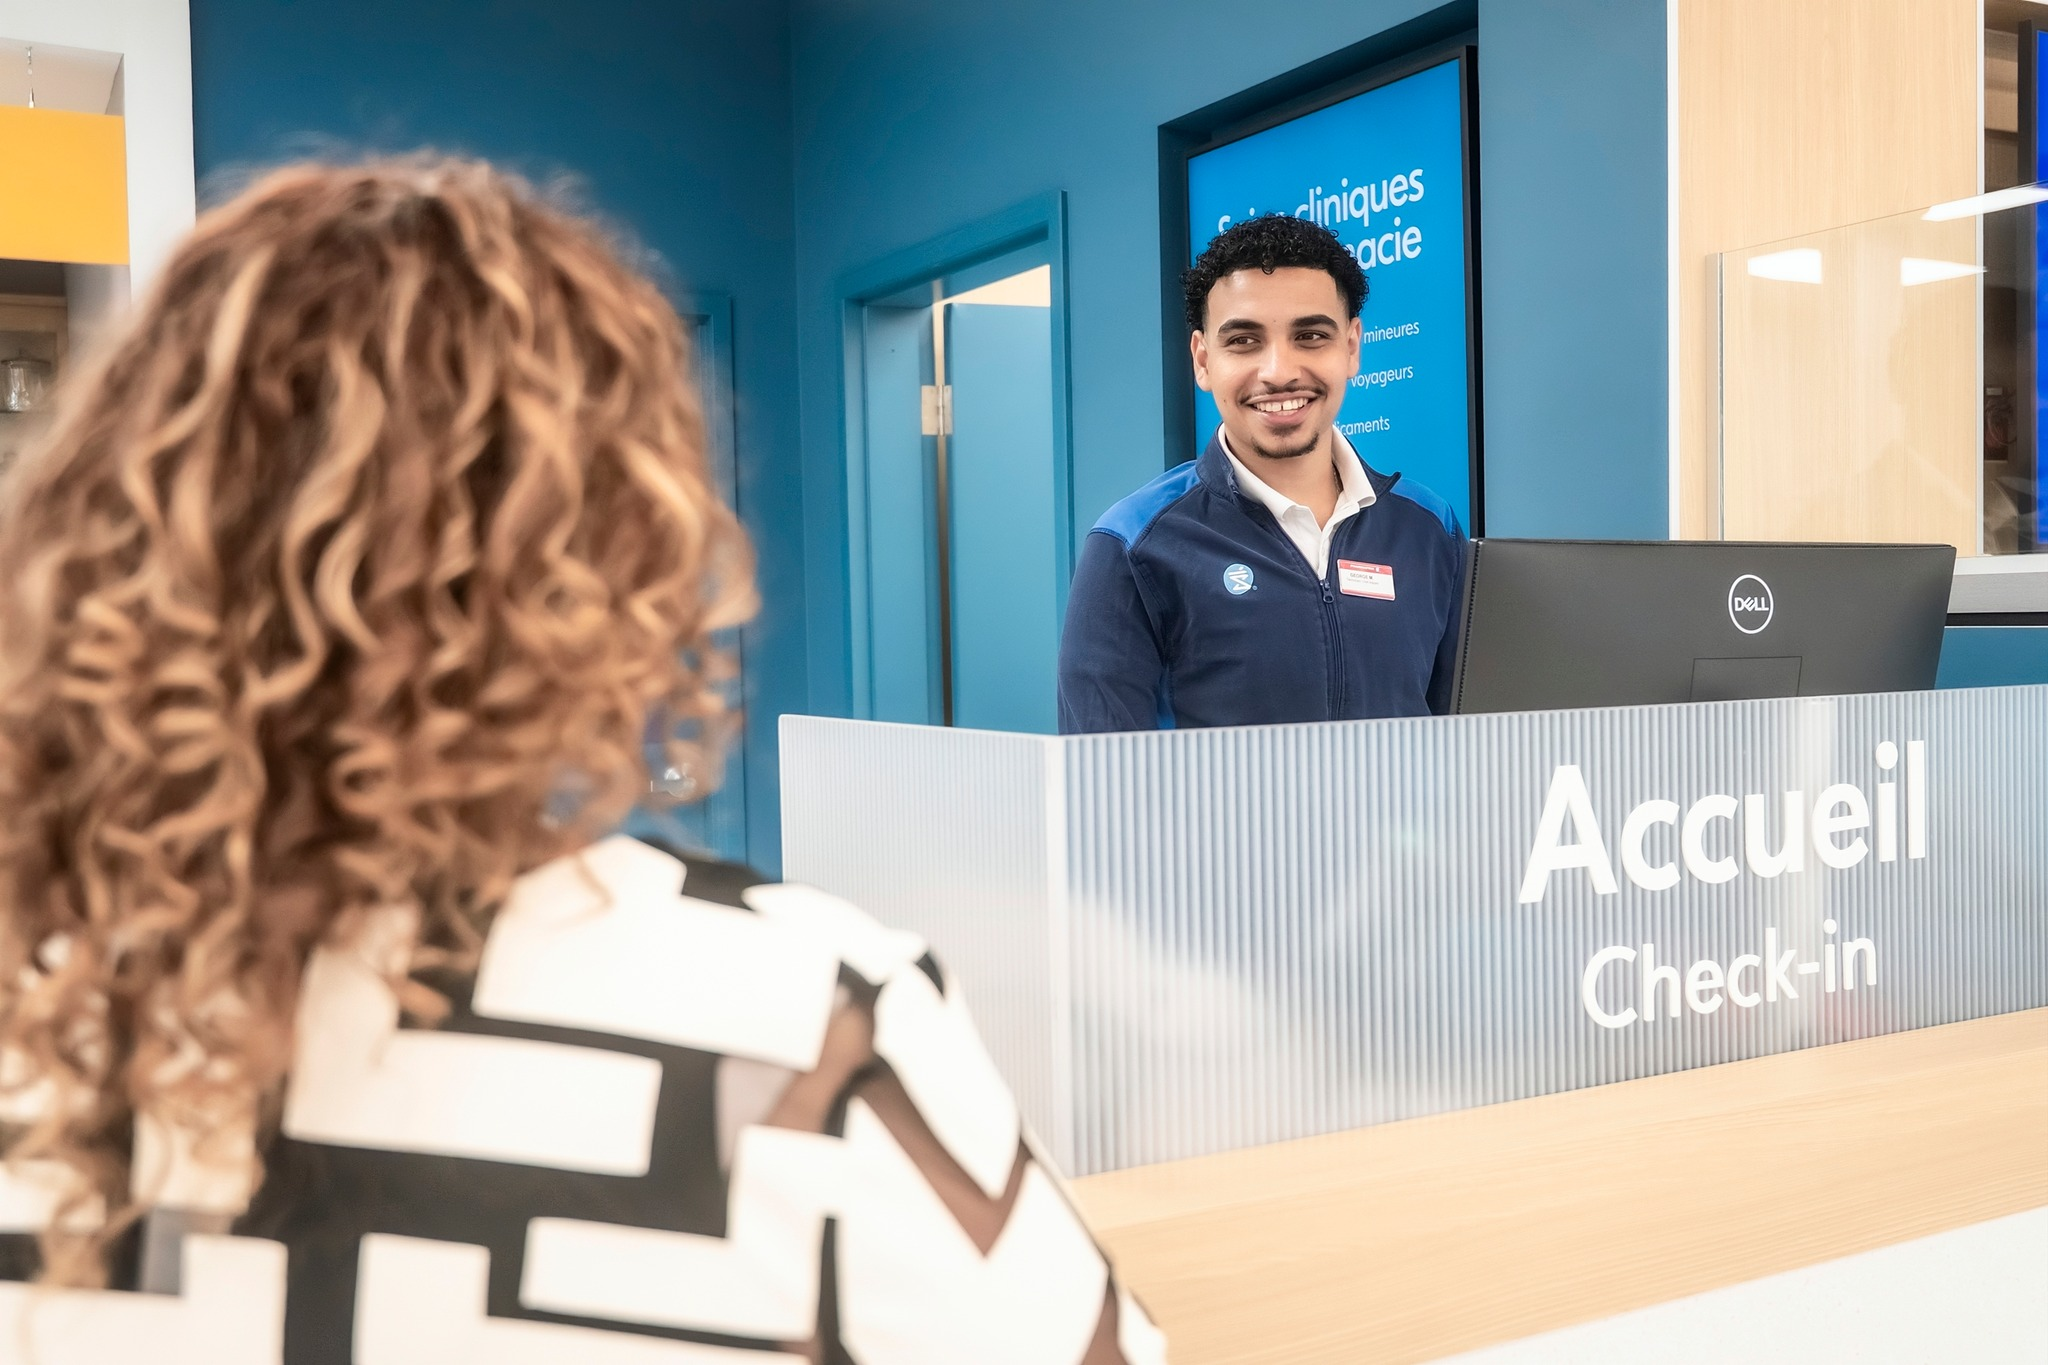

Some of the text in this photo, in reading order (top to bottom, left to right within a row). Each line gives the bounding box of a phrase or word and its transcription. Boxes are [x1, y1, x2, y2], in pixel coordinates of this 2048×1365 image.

[1363, 321, 1420, 344] mineures
[1351, 366, 1414, 390] voyageurs
[1334, 416, 1391, 436] caments
[1734, 596, 1769, 612] DELL
[1517, 740, 1926, 904] Accueil
[1582, 918, 1877, 1029] Check-in
